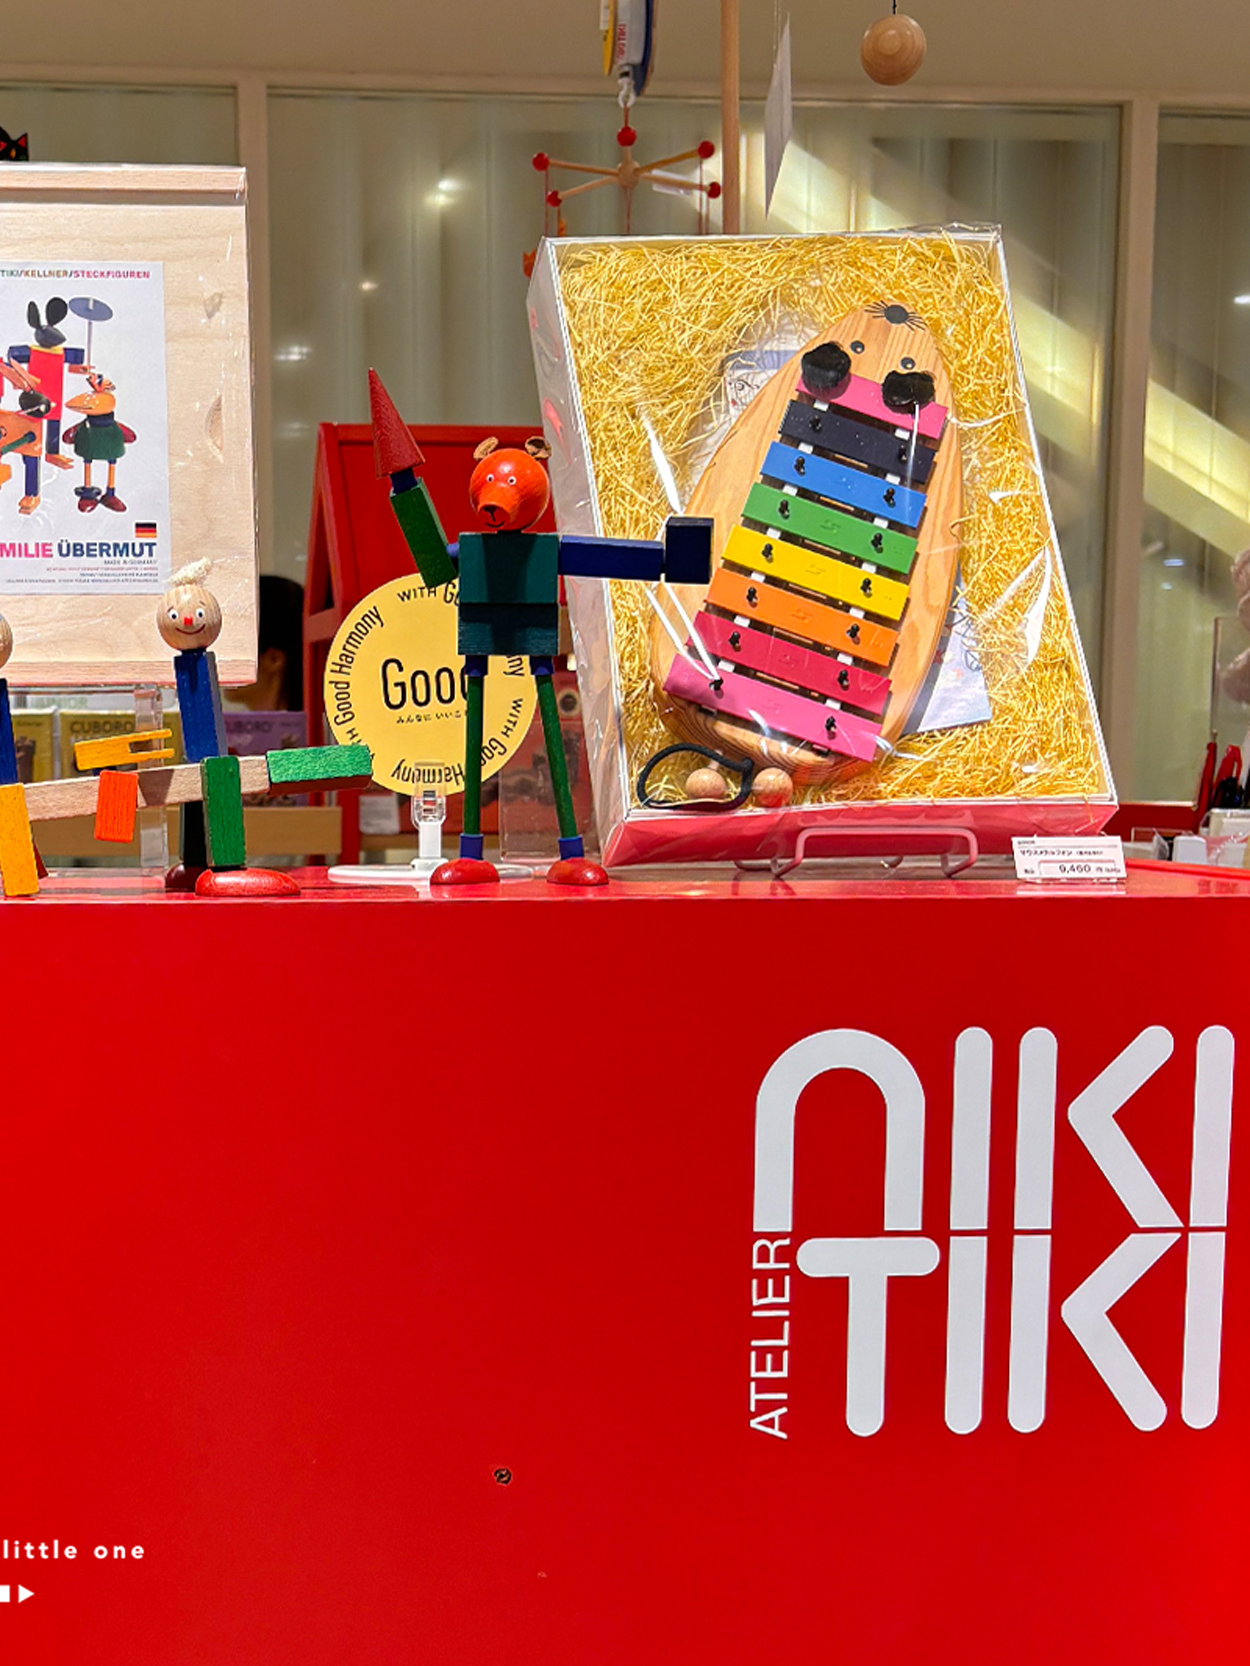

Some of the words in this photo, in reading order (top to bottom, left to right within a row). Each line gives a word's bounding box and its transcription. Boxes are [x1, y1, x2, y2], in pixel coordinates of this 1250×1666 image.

[57, 539, 157, 558] ÜBERMUT
[397, 586, 437, 602] WITH
[330, 605, 385, 676] Harmony
[328, 680, 355, 727] Good
[501, 698, 523, 738] WITH
[753, 1025, 1235, 1232] NIKI
[750, 1237, 790, 1439] ATELIER
[796, 1232, 1226, 1437] TIKI
